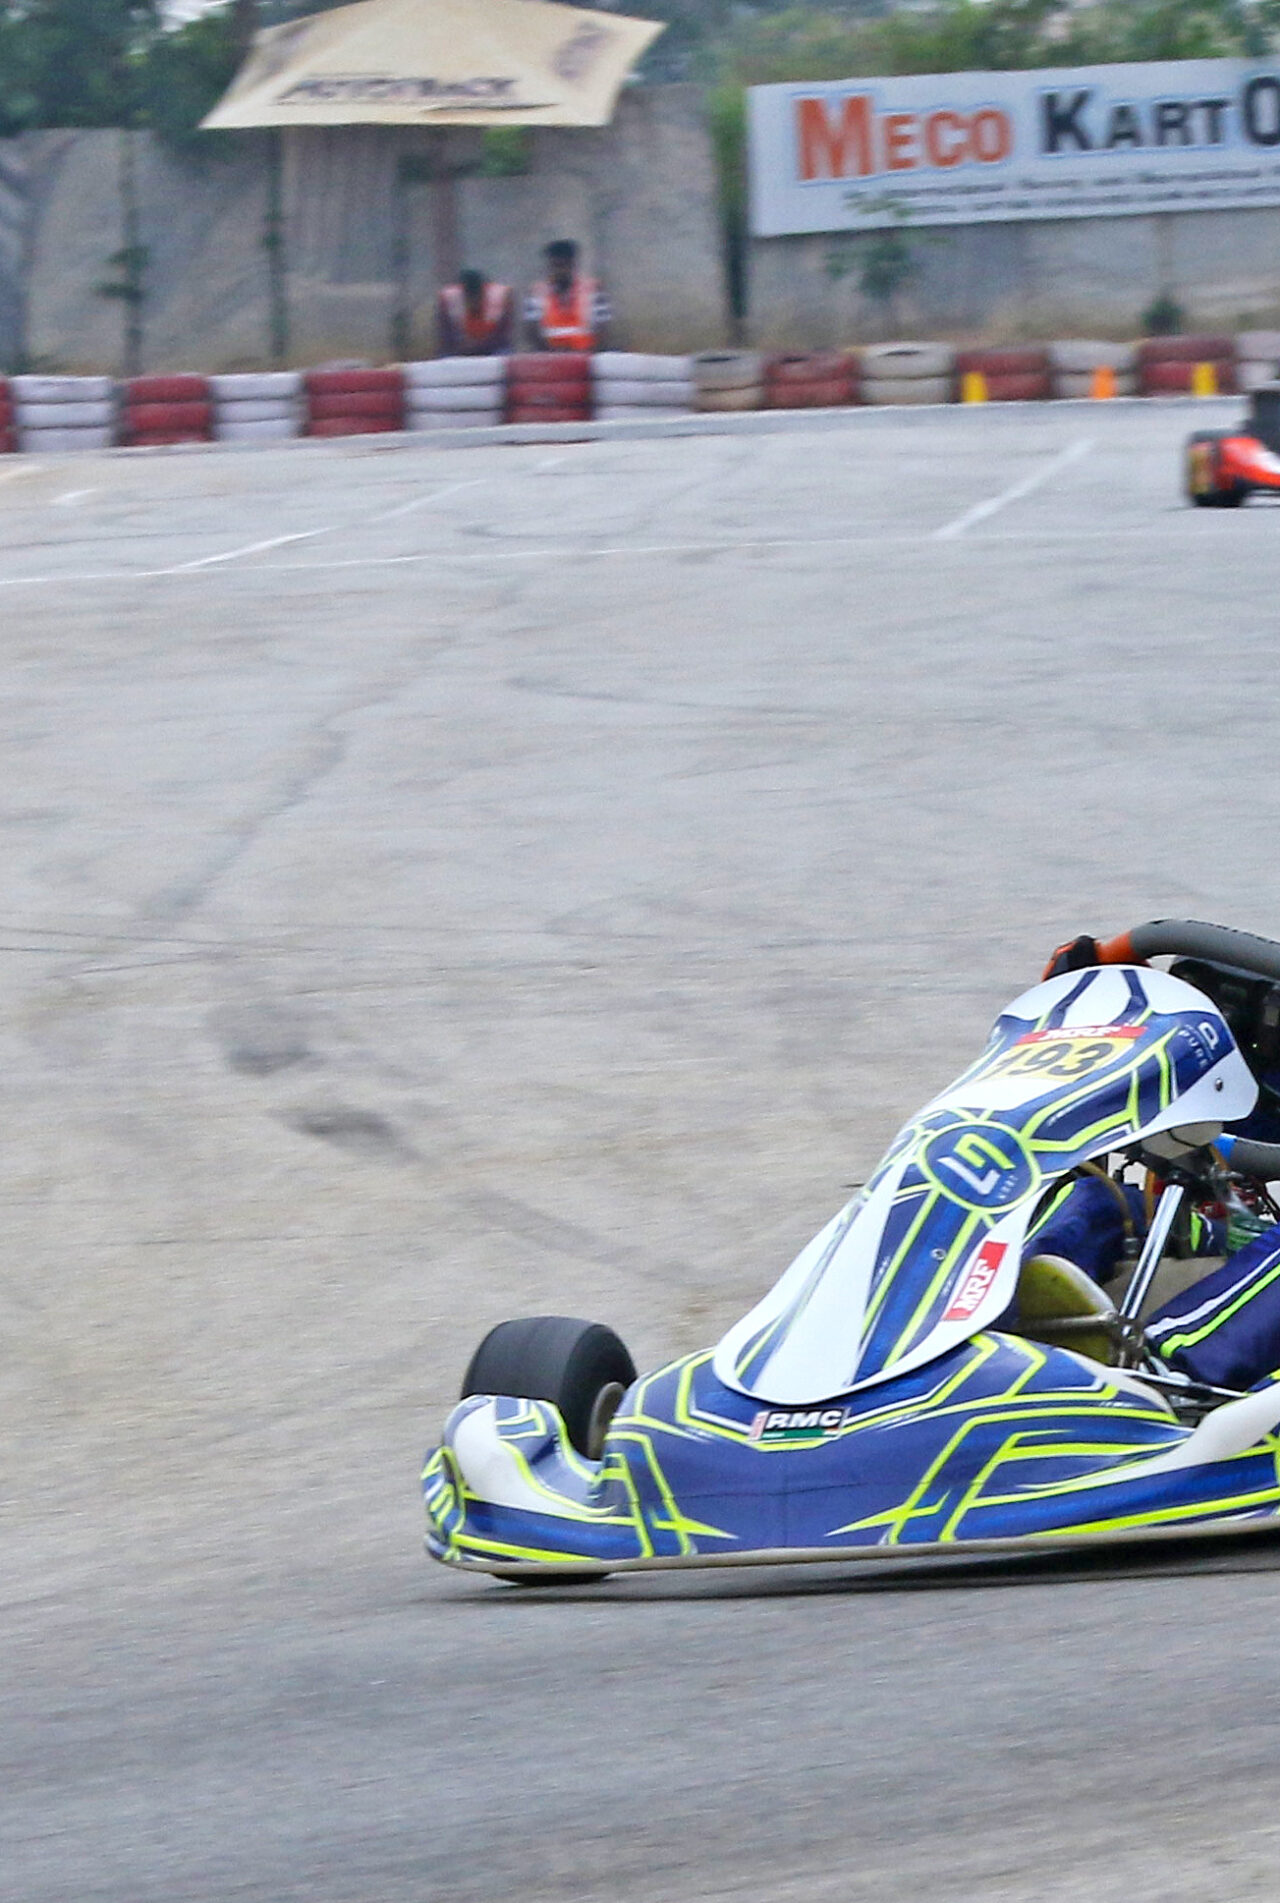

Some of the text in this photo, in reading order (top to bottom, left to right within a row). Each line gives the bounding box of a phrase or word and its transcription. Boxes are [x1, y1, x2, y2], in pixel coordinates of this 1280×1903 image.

[976, 1041, 1113, 1081] 193
[952, 1258, 996, 1311] MRF
[764, 1410, 842, 1429] RMC
